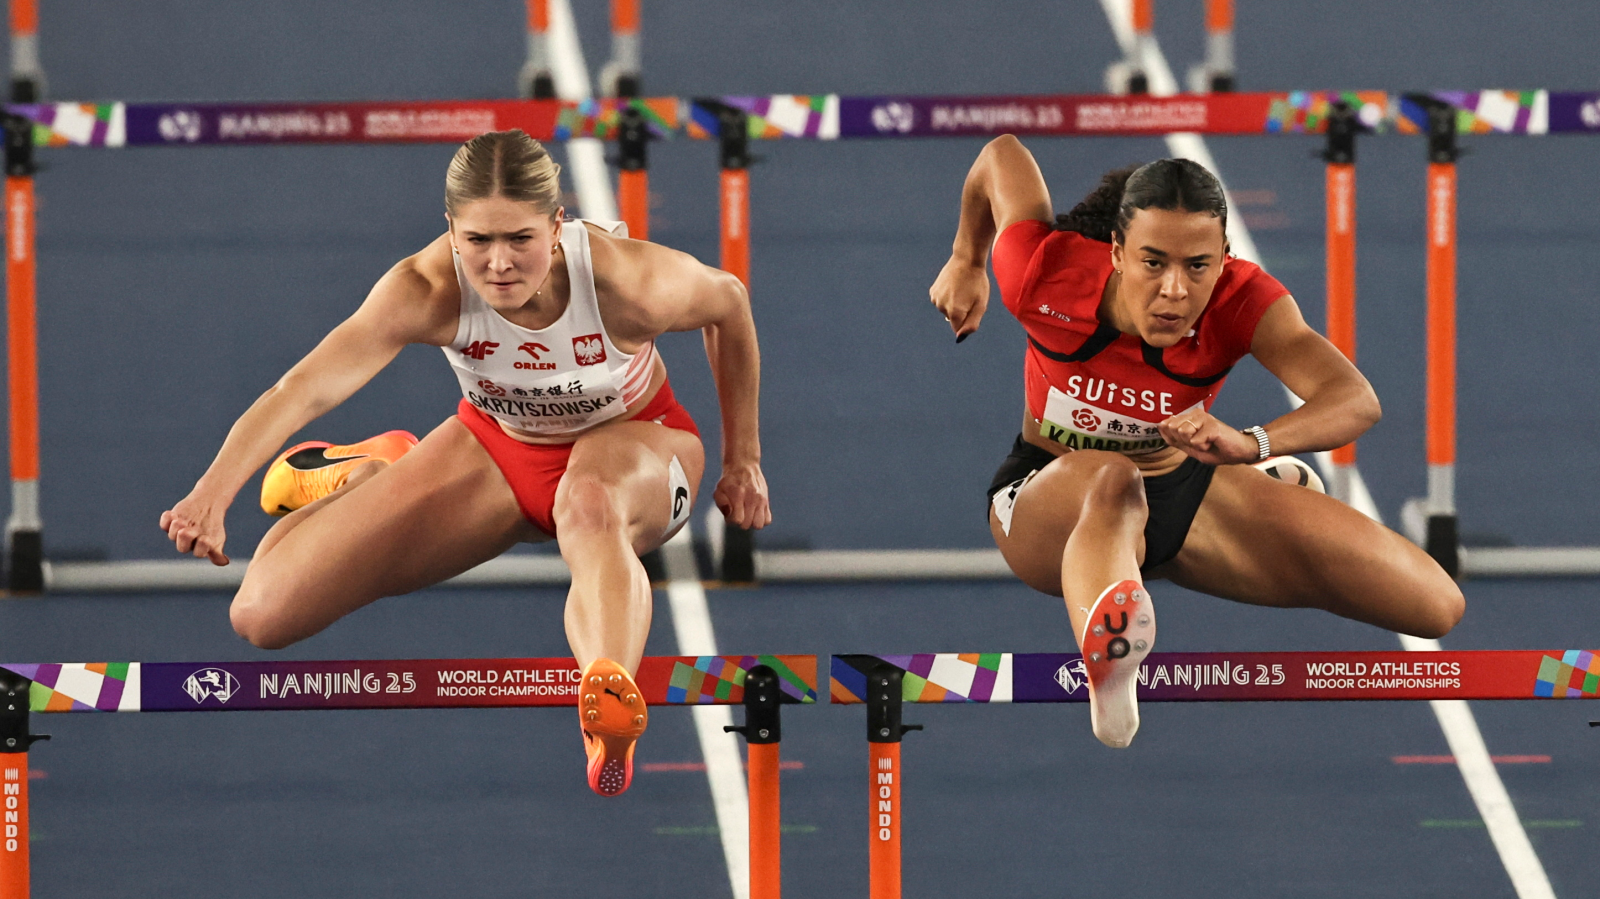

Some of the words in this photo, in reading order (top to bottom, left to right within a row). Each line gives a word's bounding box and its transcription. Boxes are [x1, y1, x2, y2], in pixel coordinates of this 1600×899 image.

[513, 361, 556, 370] ORLEN
[512, 380, 583, 396] 南京银行
[467, 390, 617, 418] SKRZYSZOWSKA
[1107, 419, 1158, 434] 南京银
[673, 486, 688, 520] 6
[437, 670, 499, 684] WORLD
[502, 669, 582, 683] ATHLETIC
[1255, 664, 1286, 686] 25
[1306, 662, 1367, 676] WORLD
[1371, 662, 1461, 676] ATHLETICS
[260, 669, 381, 699] NANJING
[386, 672, 417, 693] 25
[437, 685, 487, 697] INDOOR
[489, 684, 580, 696] CHAMPIONSHI
[1306, 678, 1354, 689] INDOOR
[1357, 677, 1461, 689] CHAMPIONSHIPS
[878, 772, 893, 841] MONDO
[4, 783, 20, 852] MONDO
